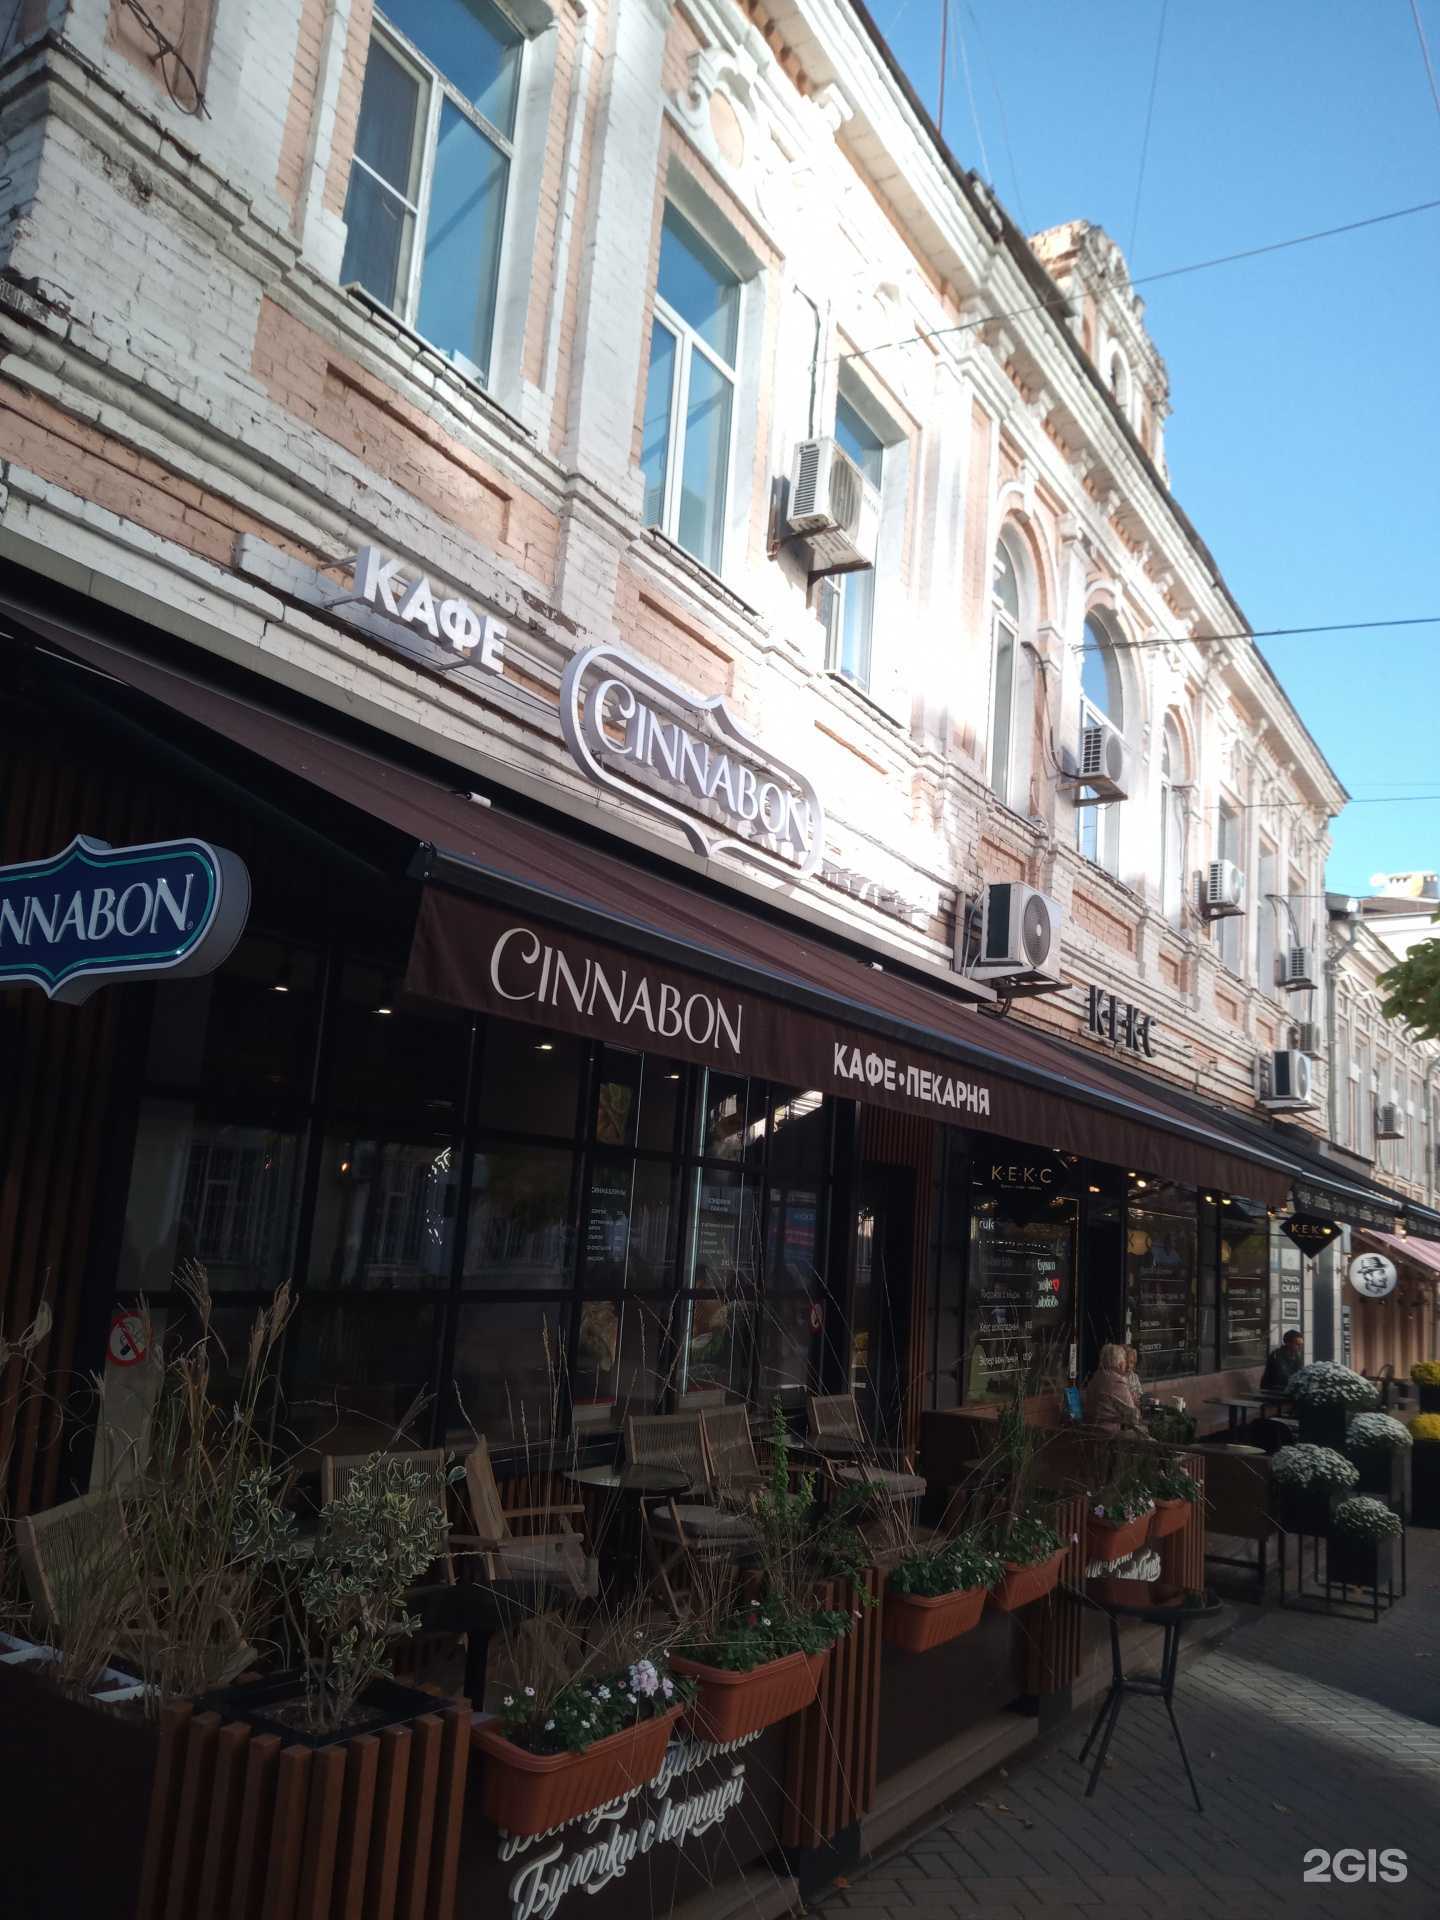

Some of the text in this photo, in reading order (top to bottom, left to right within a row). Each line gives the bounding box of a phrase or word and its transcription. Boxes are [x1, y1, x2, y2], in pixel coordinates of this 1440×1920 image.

[355, 545, 510, 676] КАФЕ
[588, 678, 813, 853] CINNABON
[489, 927, 743, 1056] CINNABON
